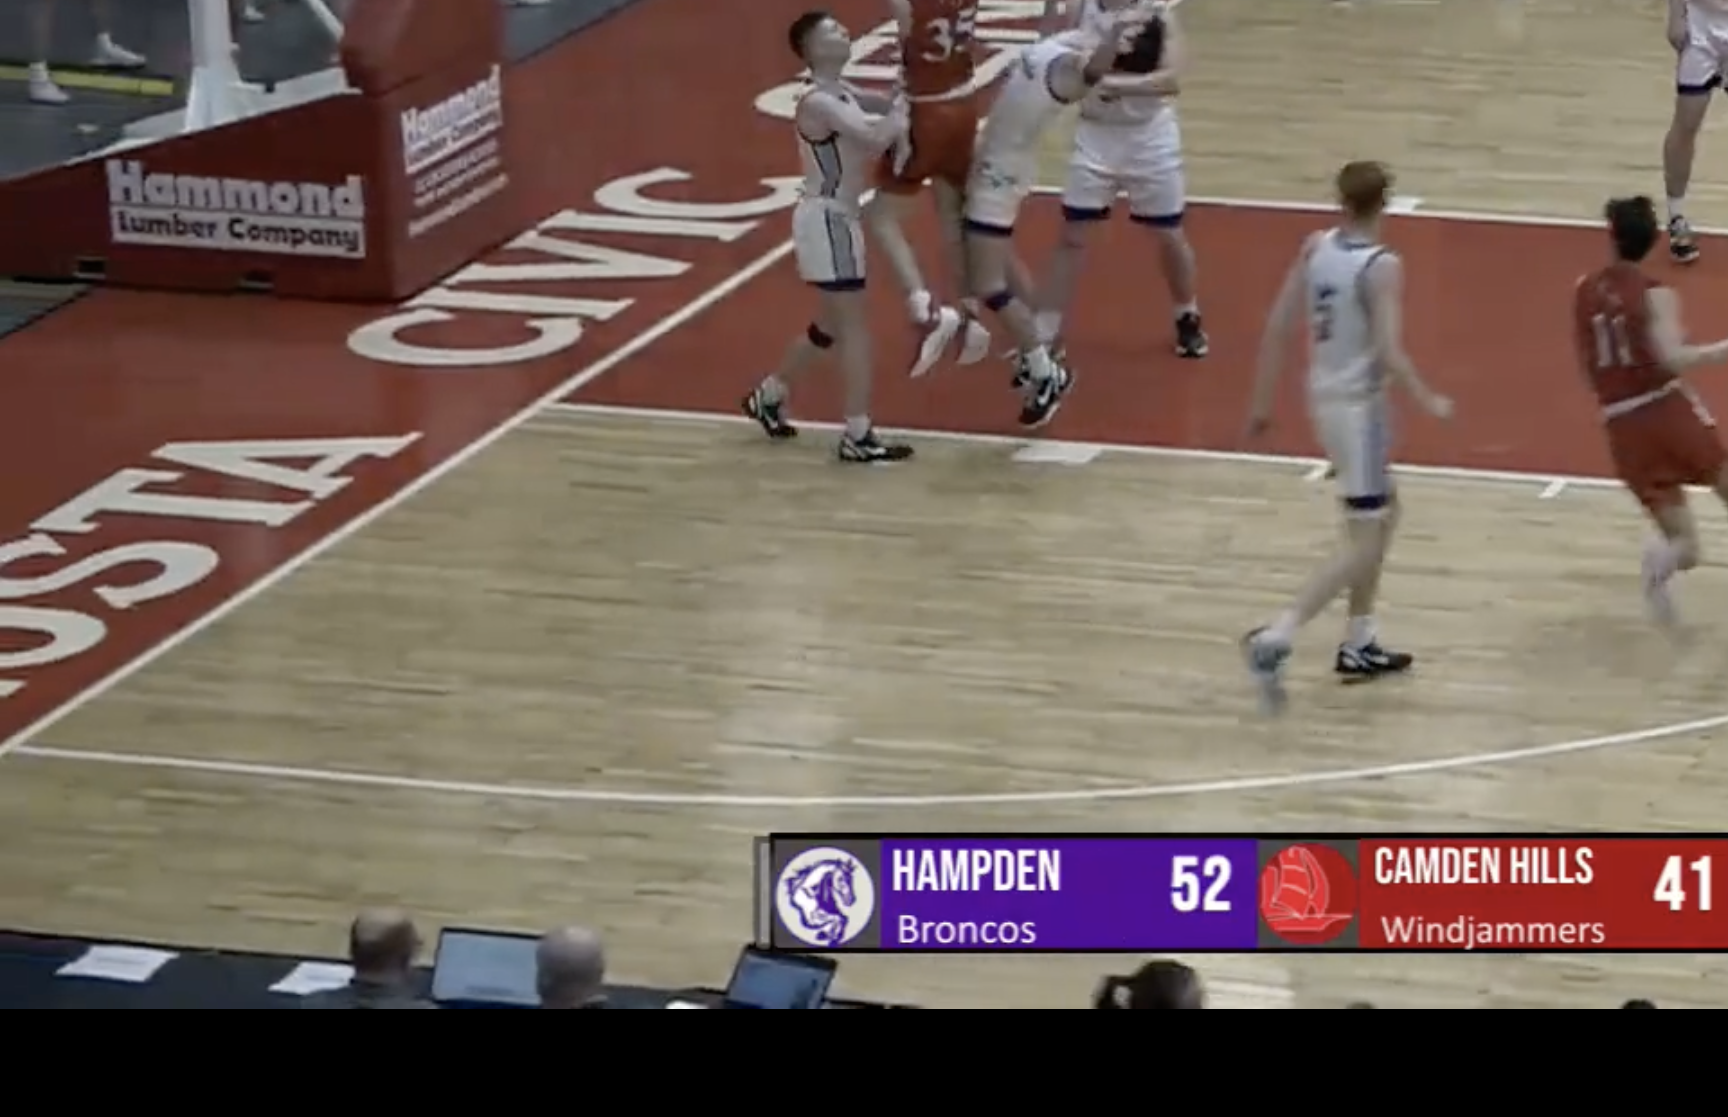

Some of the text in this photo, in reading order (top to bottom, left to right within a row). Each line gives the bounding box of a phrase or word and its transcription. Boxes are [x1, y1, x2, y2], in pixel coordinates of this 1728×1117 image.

[107, 158, 364, 217] Hammond
[118, 210, 360, 253] Lumber Company
[346, 166, 808, 366] CIVIC
[1591, 313, 1634, 368] 11
